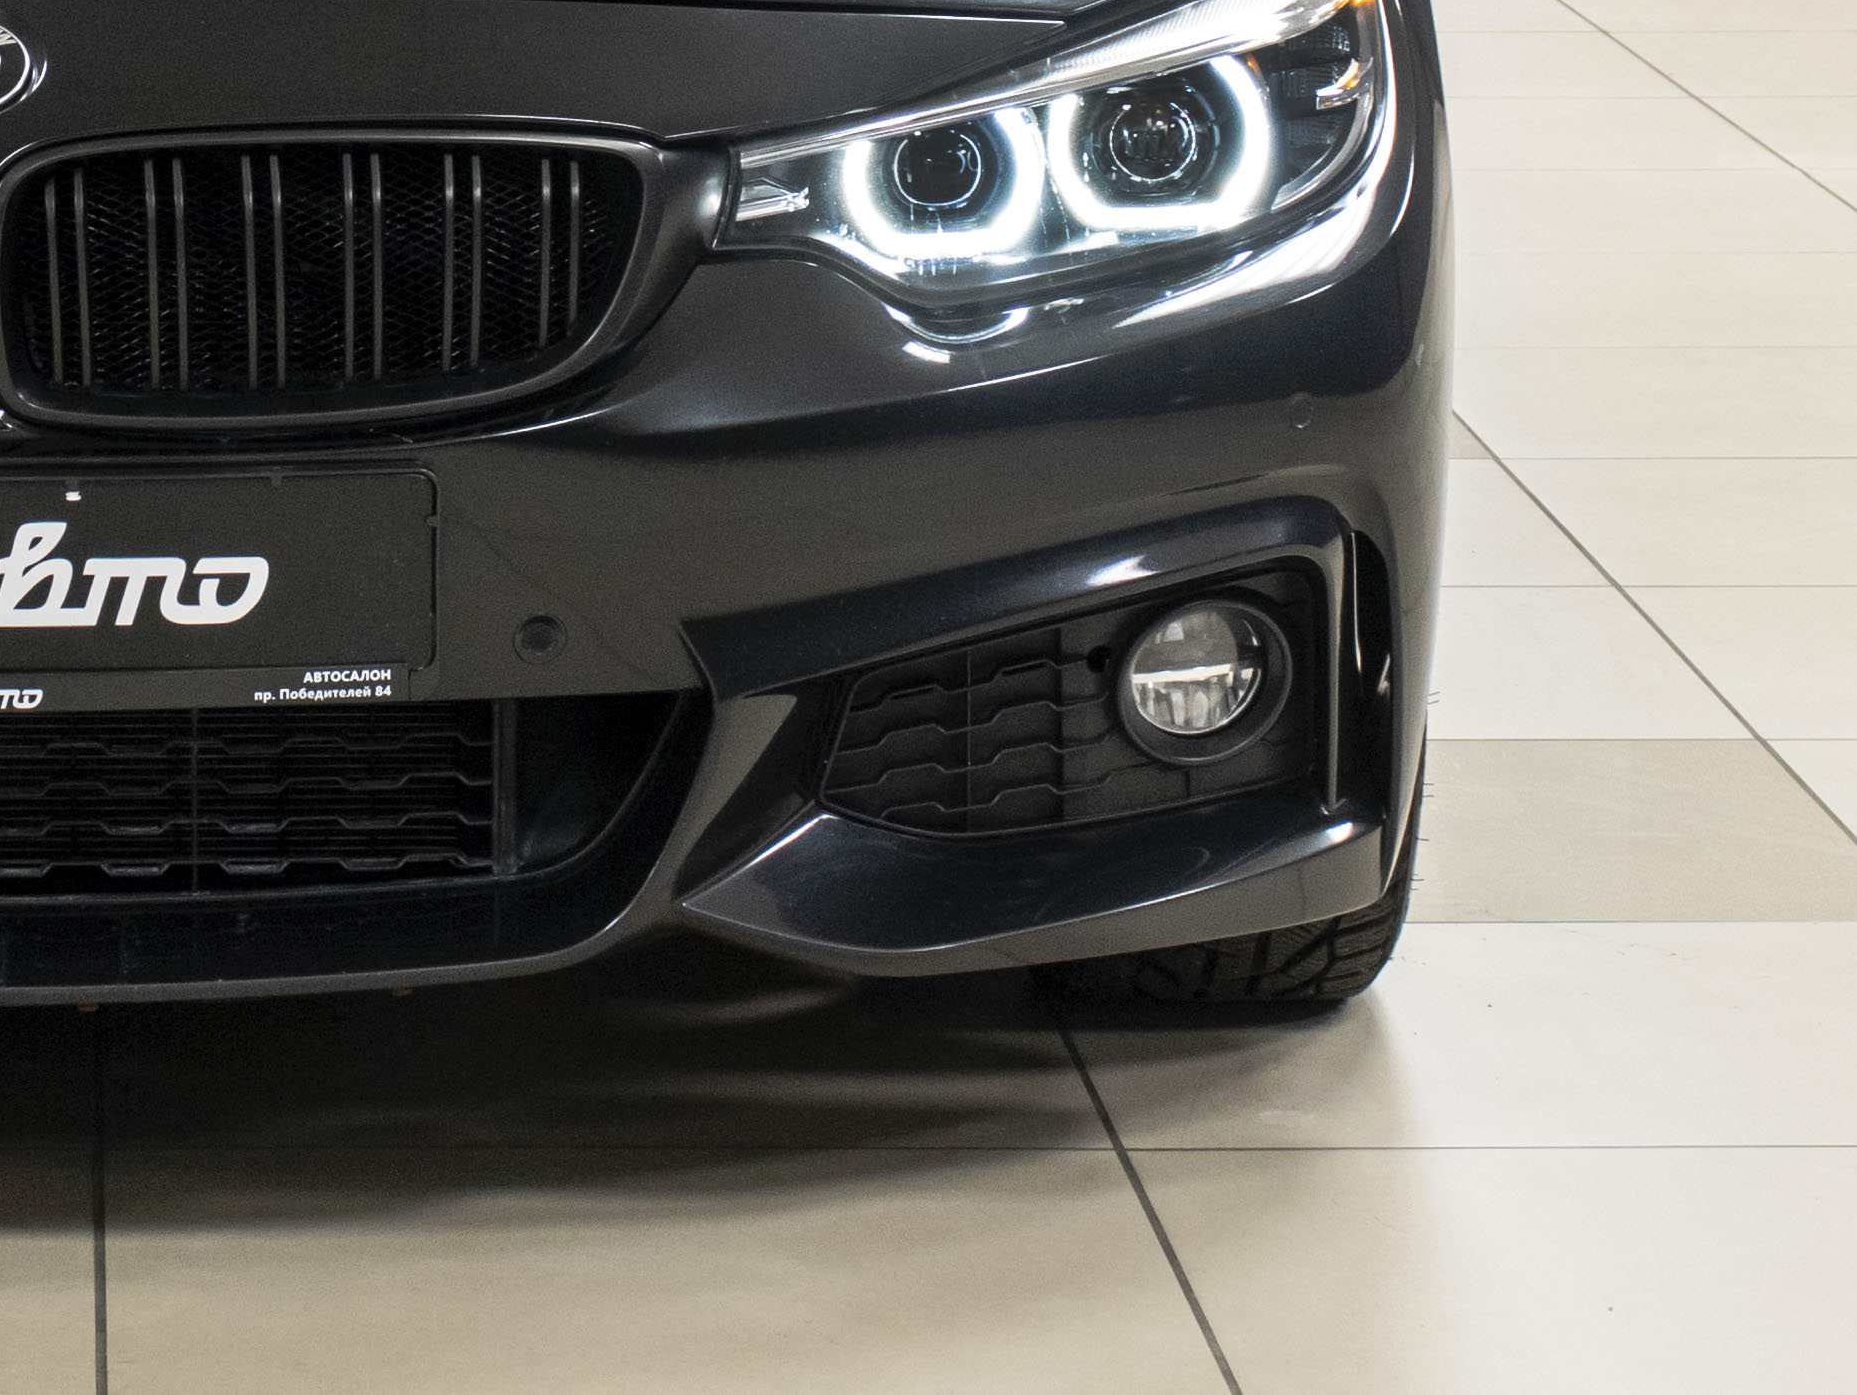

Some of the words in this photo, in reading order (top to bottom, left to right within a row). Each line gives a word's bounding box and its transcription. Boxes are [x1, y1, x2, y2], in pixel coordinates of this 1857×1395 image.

[302, 668, 392, 684] АВТОСАЛОН
[253, 691, 276, 704] пр.
[279, 685, 372, 702] Победителей
[374, 684, 392, 697] 84
